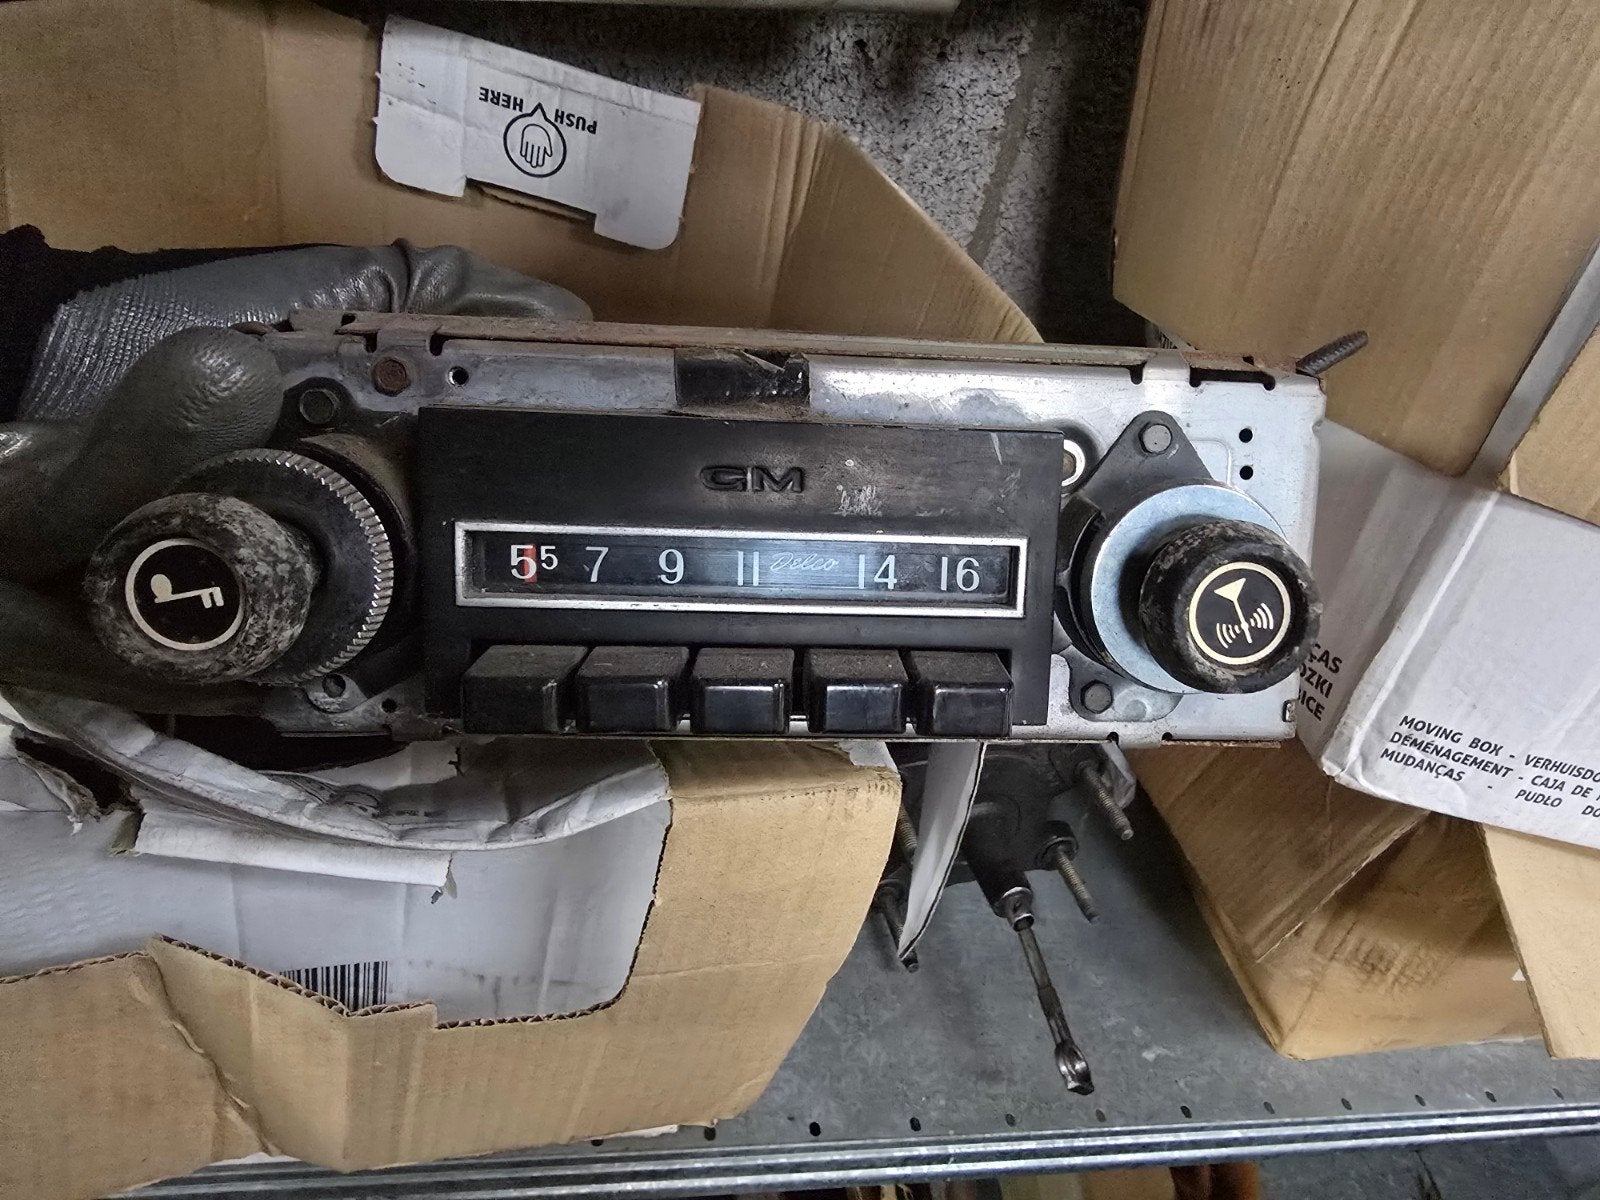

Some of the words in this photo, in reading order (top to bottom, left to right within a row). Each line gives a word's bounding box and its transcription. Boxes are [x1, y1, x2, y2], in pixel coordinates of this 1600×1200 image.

[478, 86, 524, 112] HERE
[554, 108, 598, 135] PUSH
[699, 465, 805, 493] GM
[585, 546, 609, 583] 7
[658, 549, 684, 585] 9
[770, 551, 840, 572] Delco
[858, 554, 898, 590] 14
[940, 556, 981, 592] 16
[1399, 715, 1463, 744] MOVING
[1468, 737, 1504, 757] BOX
[1380, 748, 1466, 782] MUDANÇAS
[1389, 731, 1514, 778] DÉMÉNAGEMENT
[1530, 775, 1566, 792] CAJA
[1570, 784, 1594, 799] DE
